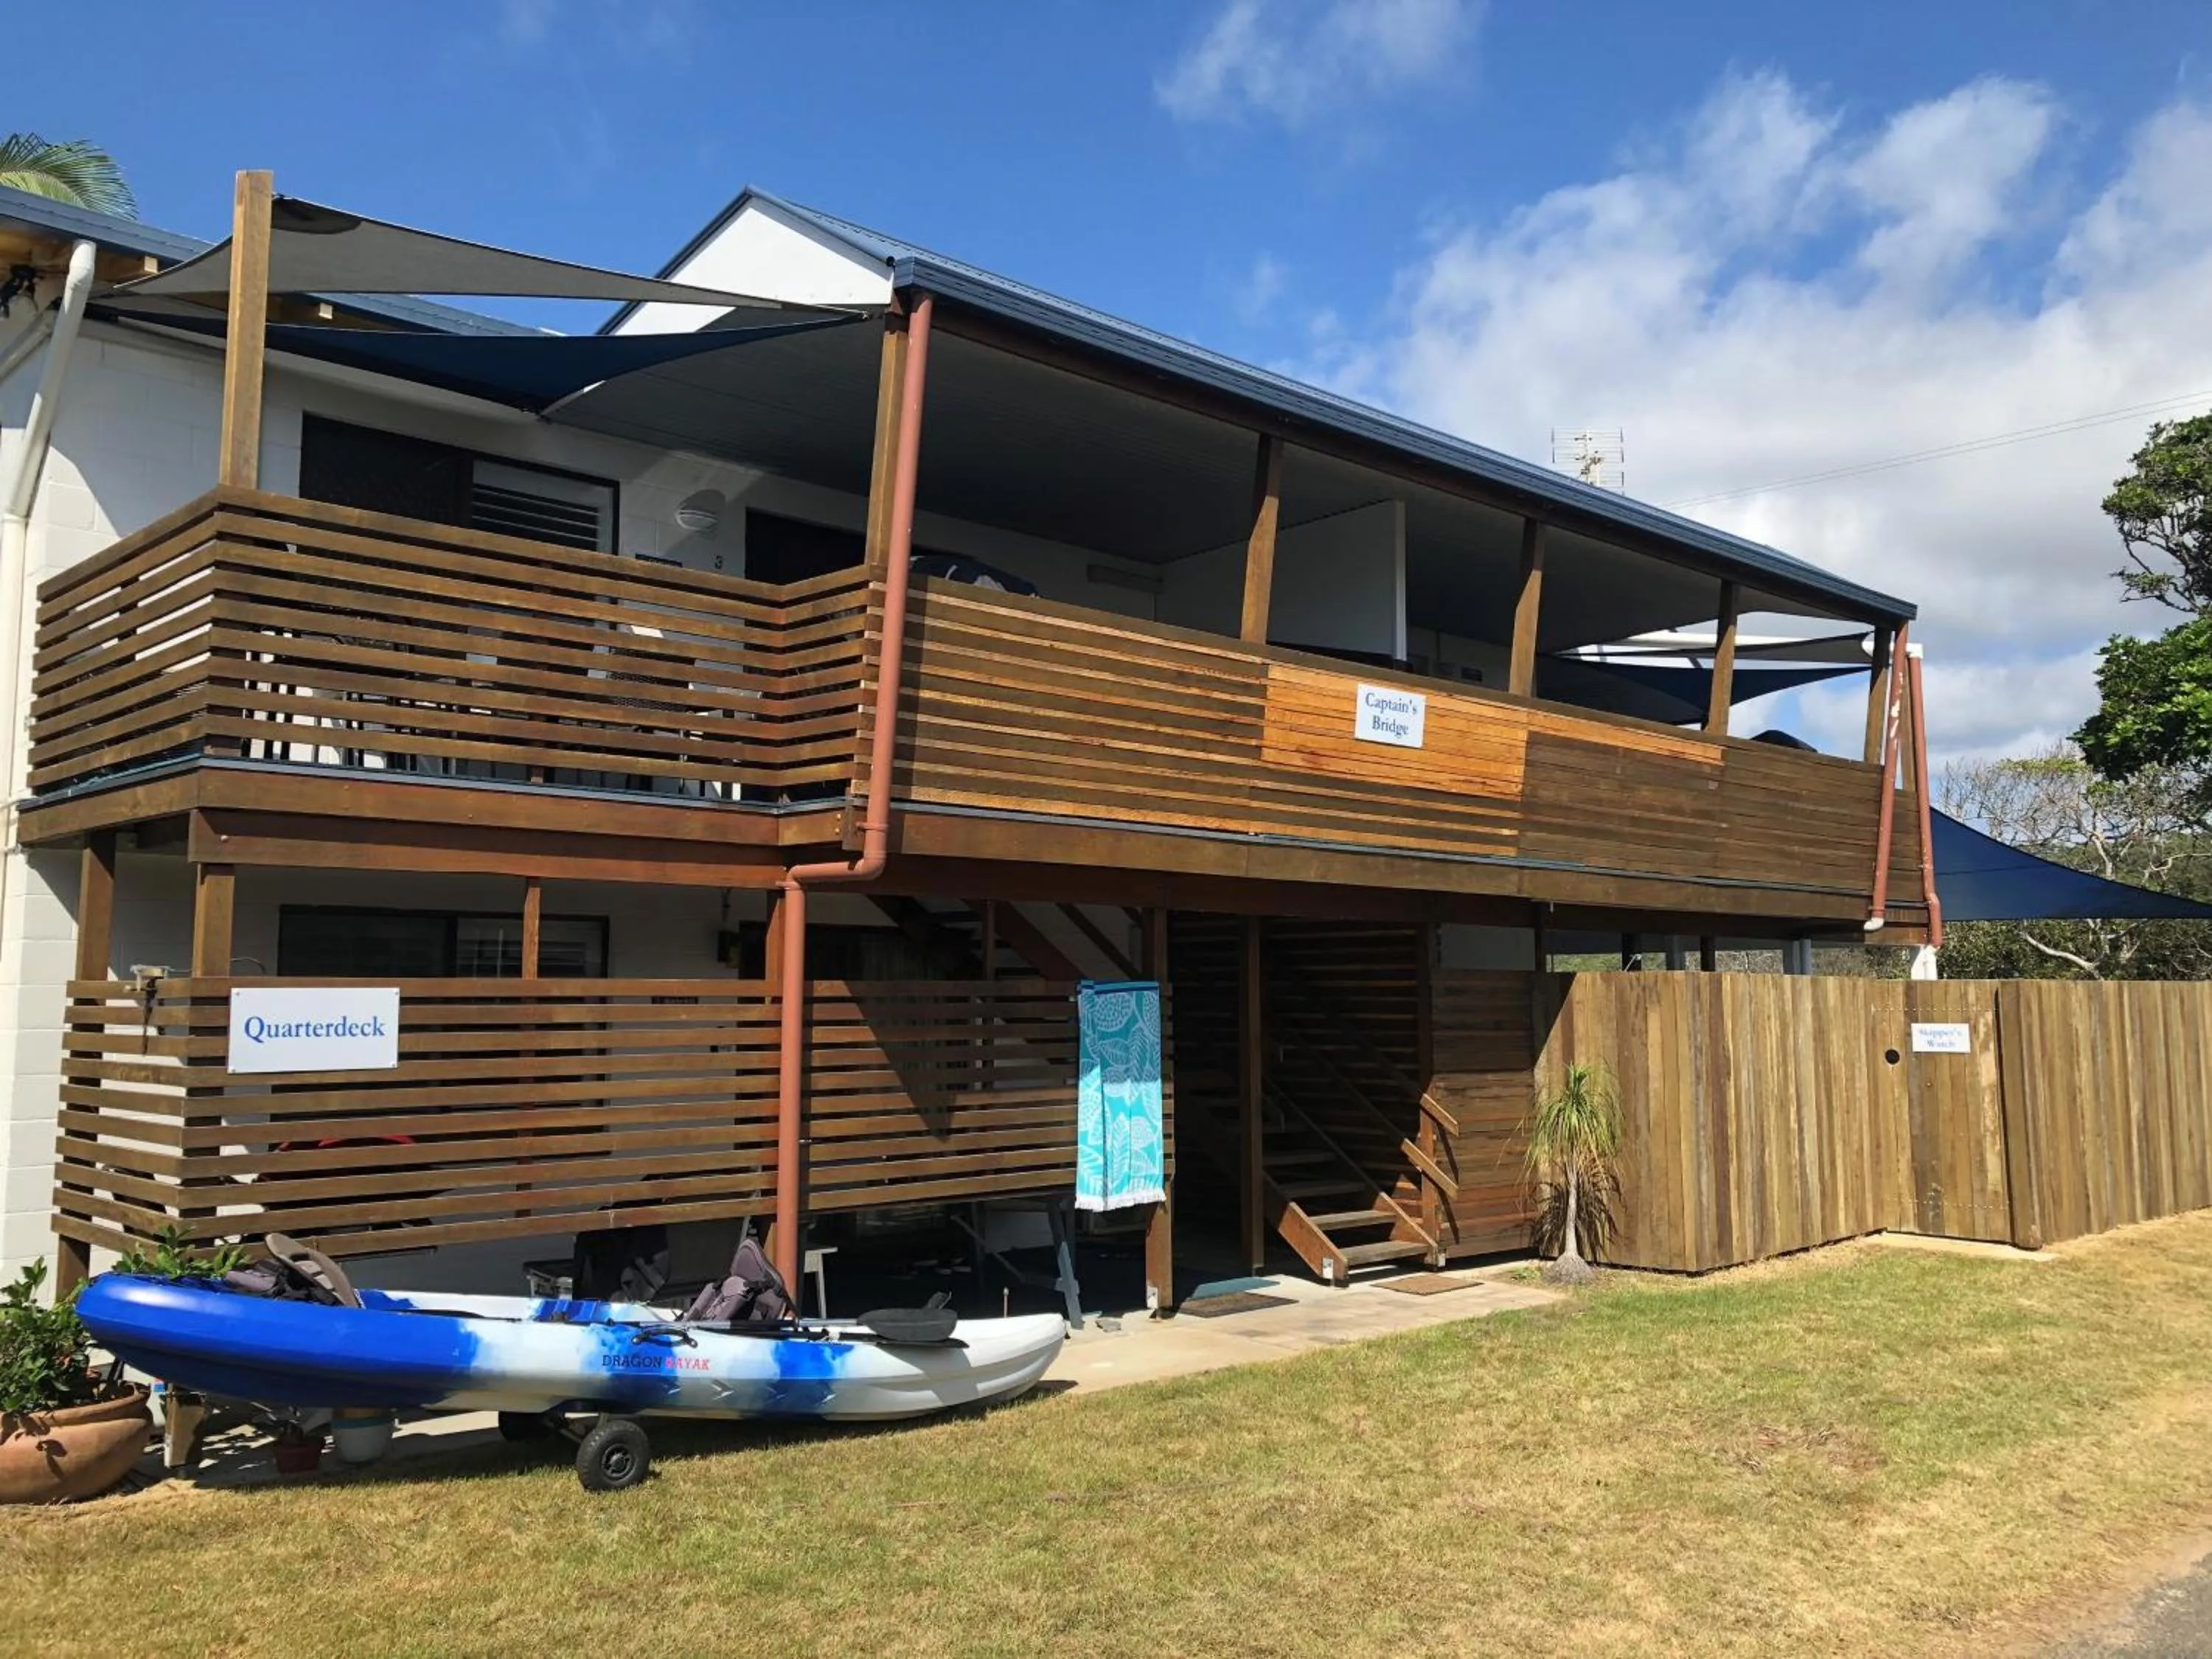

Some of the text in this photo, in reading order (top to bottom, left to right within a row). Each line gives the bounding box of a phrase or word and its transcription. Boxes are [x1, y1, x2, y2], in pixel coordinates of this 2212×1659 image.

[1365, 692, 1417, 715] Captain's
[1372, 715, 1409, 738] Bridge
[243, 1015, 386, 1043] Quarterdeck
[602, 1354, 710, 1370] DRAGON KAYAK
